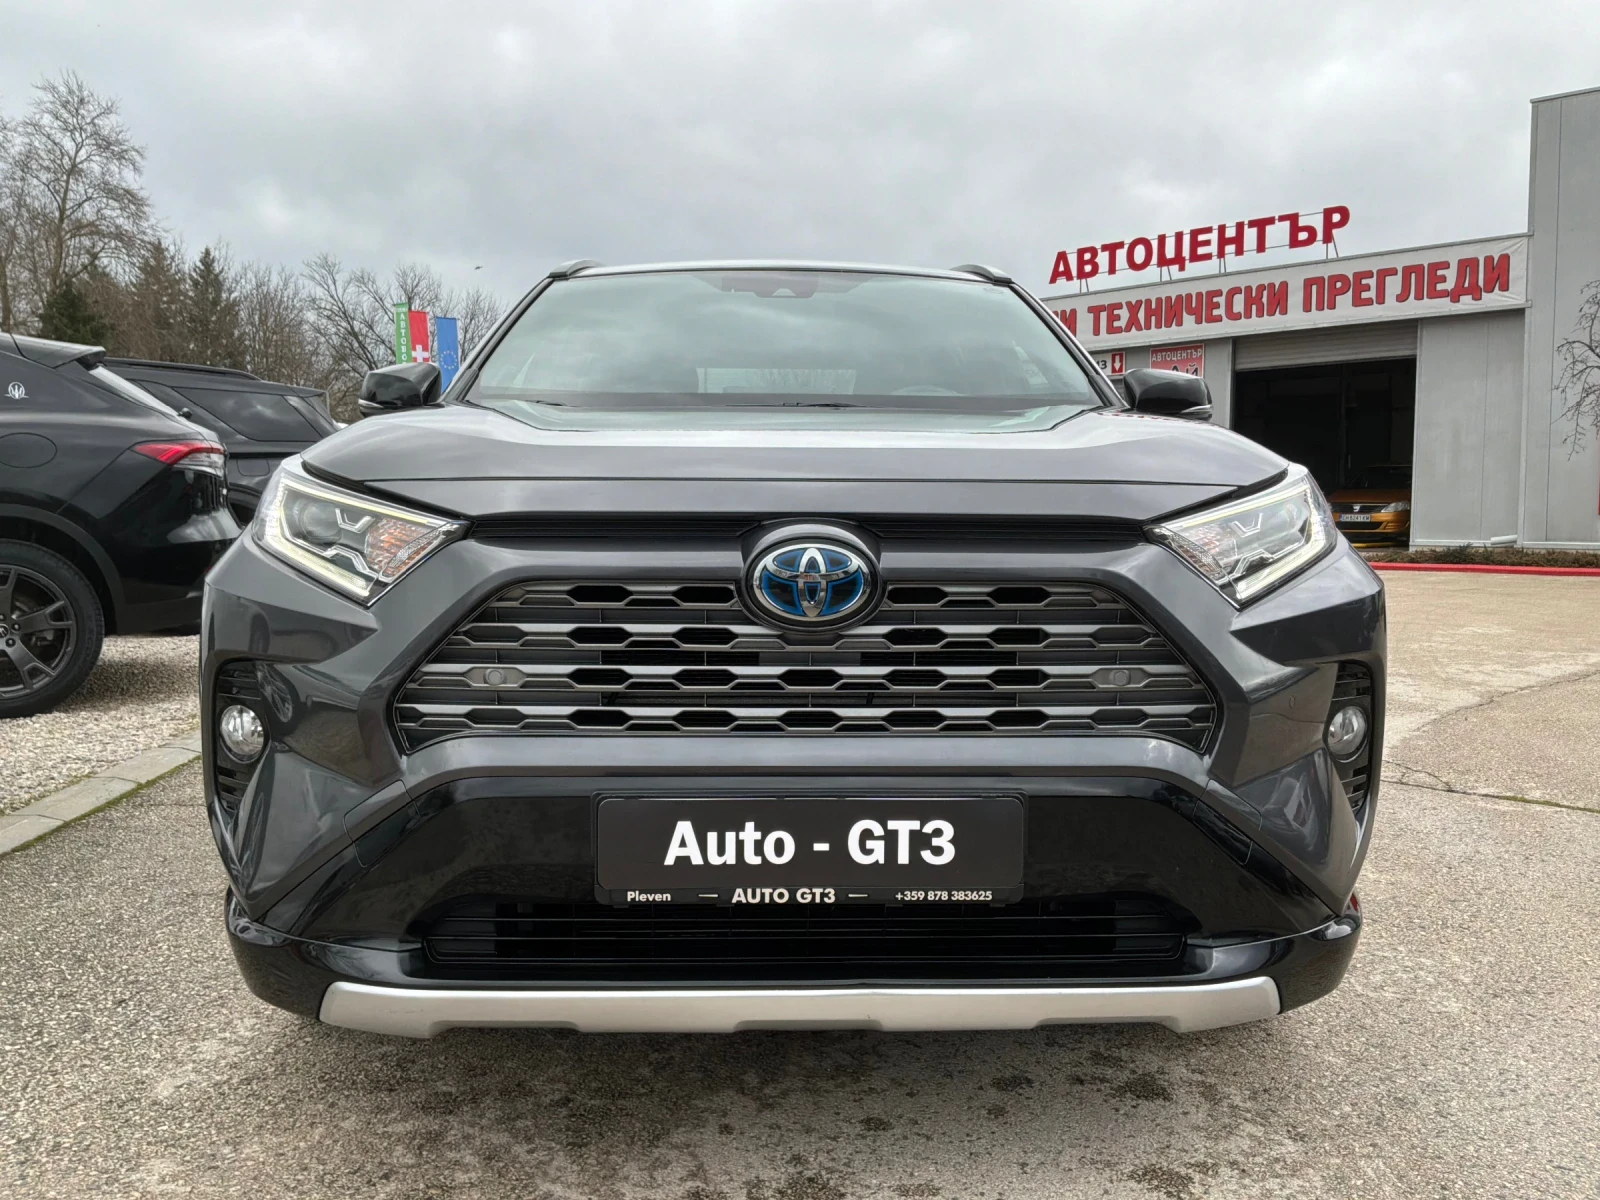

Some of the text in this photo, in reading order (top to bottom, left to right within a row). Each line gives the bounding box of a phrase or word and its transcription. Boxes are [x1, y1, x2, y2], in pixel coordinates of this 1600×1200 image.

[1049, 206, 1350, 285] АВТОЦЕНТЪР
[1087, 281, 1288, 336] ТЕХНИЧЕСКИ
[1303, 253, 1510, 313] ПРЕГЛЕДИ
[1152, 349, 1203, 362] АВТОЦЕНТЪР
[663, 821, 796, 866] Auto
[847, 819, 956, 866] GT3
[627, 890, 672, 902] Pleven
[732, 887, 836, 904] AUTO GT3
[895, 890, 993, 902] +359 878 383625
